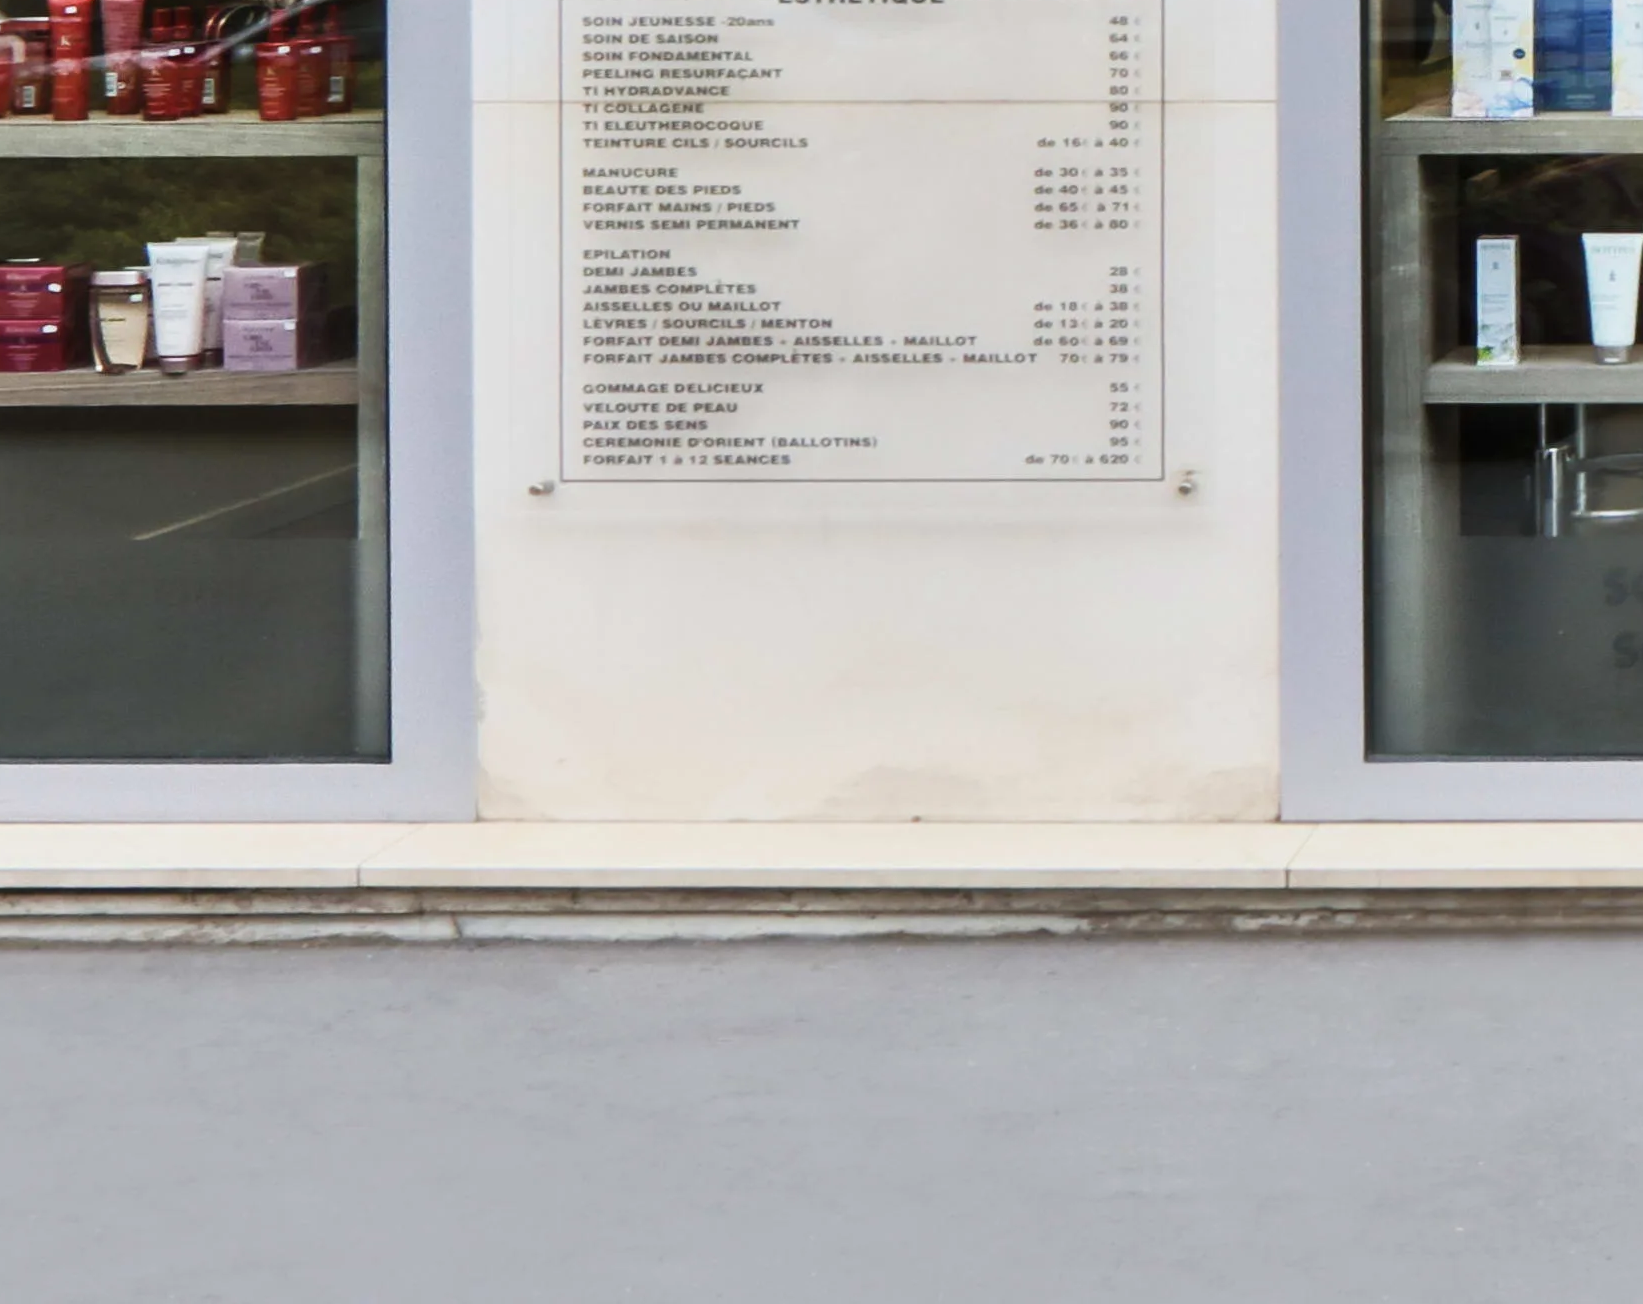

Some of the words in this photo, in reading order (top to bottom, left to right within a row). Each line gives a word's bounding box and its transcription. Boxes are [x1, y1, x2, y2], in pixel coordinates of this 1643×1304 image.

[581, 17, 623, 26] SOIN
[628, 17, 716, 26] JEUNESSE
[582, 34, 623, 44] SOIN
[656, 35, 719, 43] SAISON
[582, 52, 623, 61] SOIN
[629, 52, 753, 61] FONDAMENTAL
[582, 69, 654, 78] PEELING
[582, 138, 667, 148] TEINTURE
[671, 138, 710, 148] CILS
[724, 138, 809, 148] SOURCILS
[582, 168, 679, 177] MANUCURE
[693, 185, 742, 194] PIEDS
[582, 203, 653, 212] FORFAIT
[658, 203, 712, 212] MAINS
[727, 202, 776, 212] PIEDS
[583, 220, 645, 230] VERNIS
[650, 220, 691, 230] SEMI
[695, 220, 801, 229] PERMANENT
[582, 250, 671, 259] EPILATION
[582, 267, 624, 276] DEMI
[630, 267, 698, 276] JAMBES
[582, 285, 651, 294] JAMBES
[582, 302, 673, 311] AISSELLES
[708, 302, 782, 311] MAILLOT
[662, 319, 746, 328] SOURCILS
[761, 319, 833, 328] MENTON
[583, 337, 653, 346] FORFAIT
[658, 337, 700, 346] DEMI
[706, 337, 773, 346] JAMBES
[793, 336, 884, 346] AISSELLES
[903, 336, 977, 346] MAILLOT
[583, 354, 654, 363] FORFAIT
[658, 354, 727, 364] JAMBES
[852, 354, 944, 363] AISSELLES
[962, 354, 1038, 363] MAILLOT
[582, 384, 669, 393] GOMMAGE
[693, 403, 739, 413] PEAU
[581, 421, 620, 430] PAIX
[665, 420, 708, 430] SENS
[583, 455, 654, 464] FORFAIT
